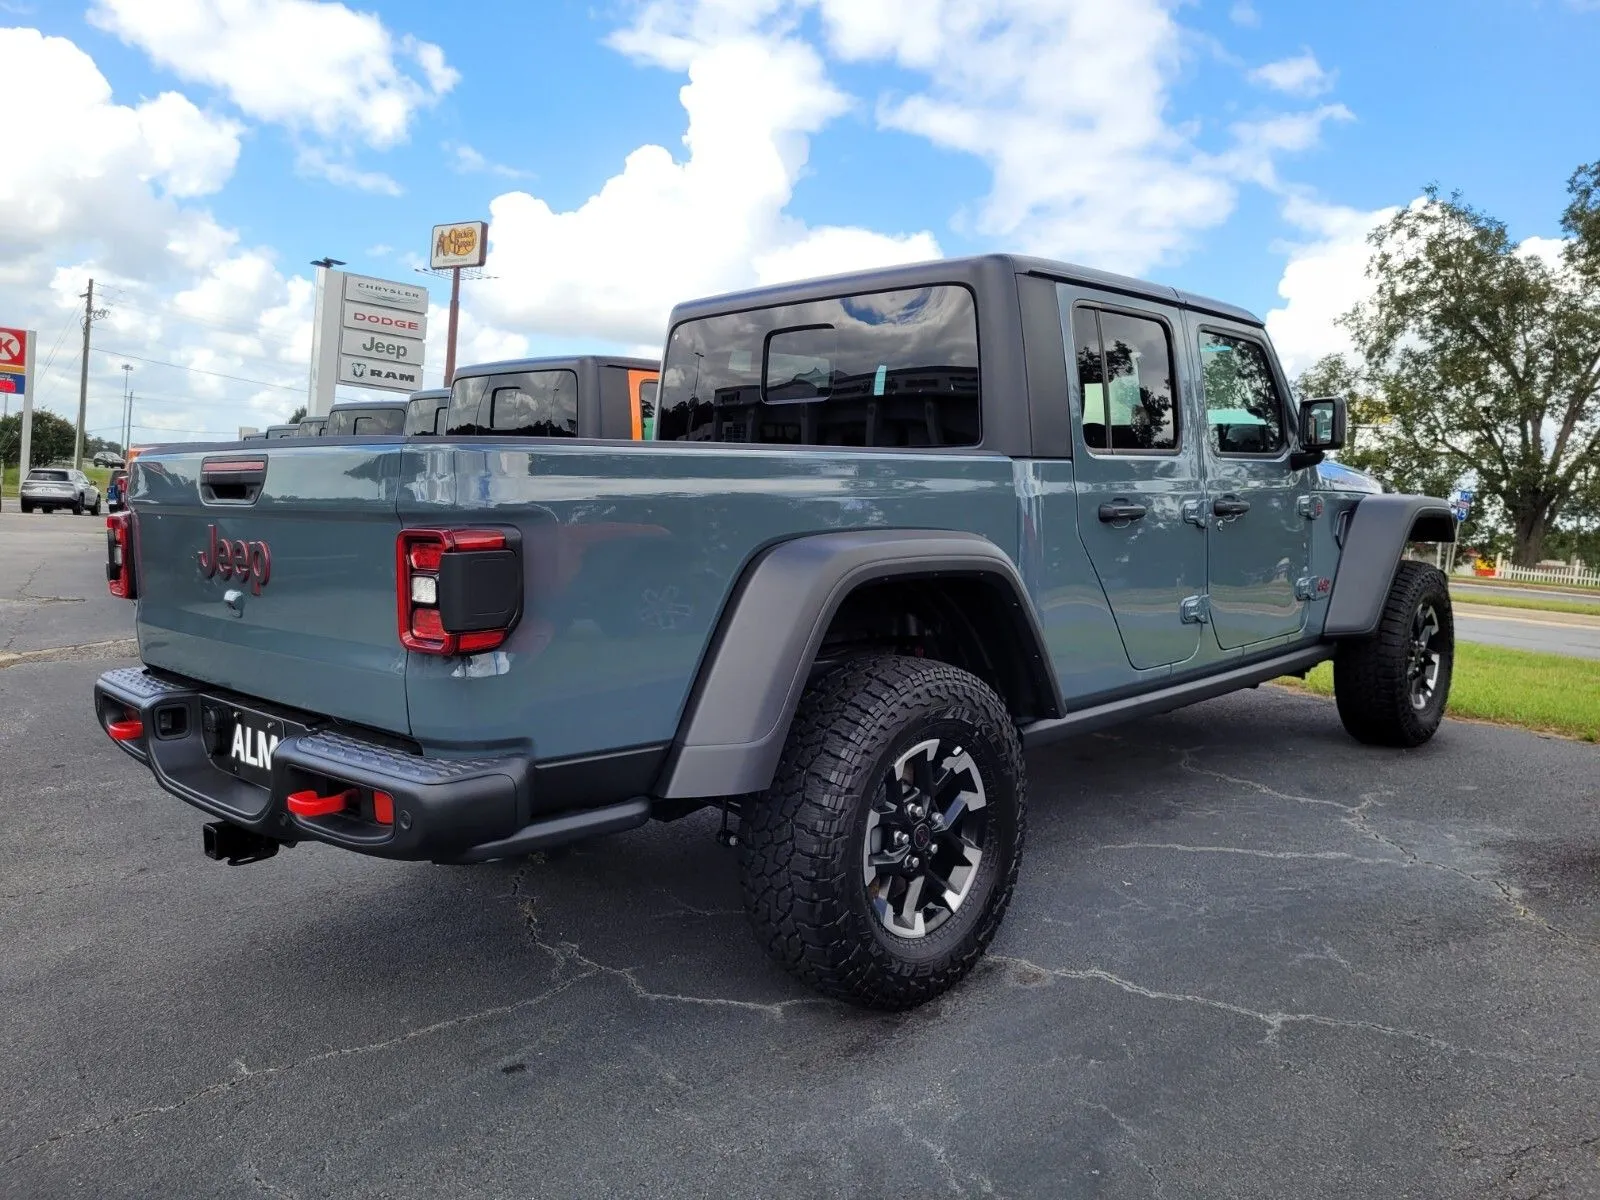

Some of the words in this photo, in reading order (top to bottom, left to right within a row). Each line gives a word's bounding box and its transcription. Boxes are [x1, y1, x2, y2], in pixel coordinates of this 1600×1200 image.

[357, 282, 420, 299] CHRYSLER
[353, 312, 419, 331] DODGE
[362, 336, 408, 359] Jeep
[370, 368, 416, 383] RAM
[198, 524, 272, 597] Jeep
